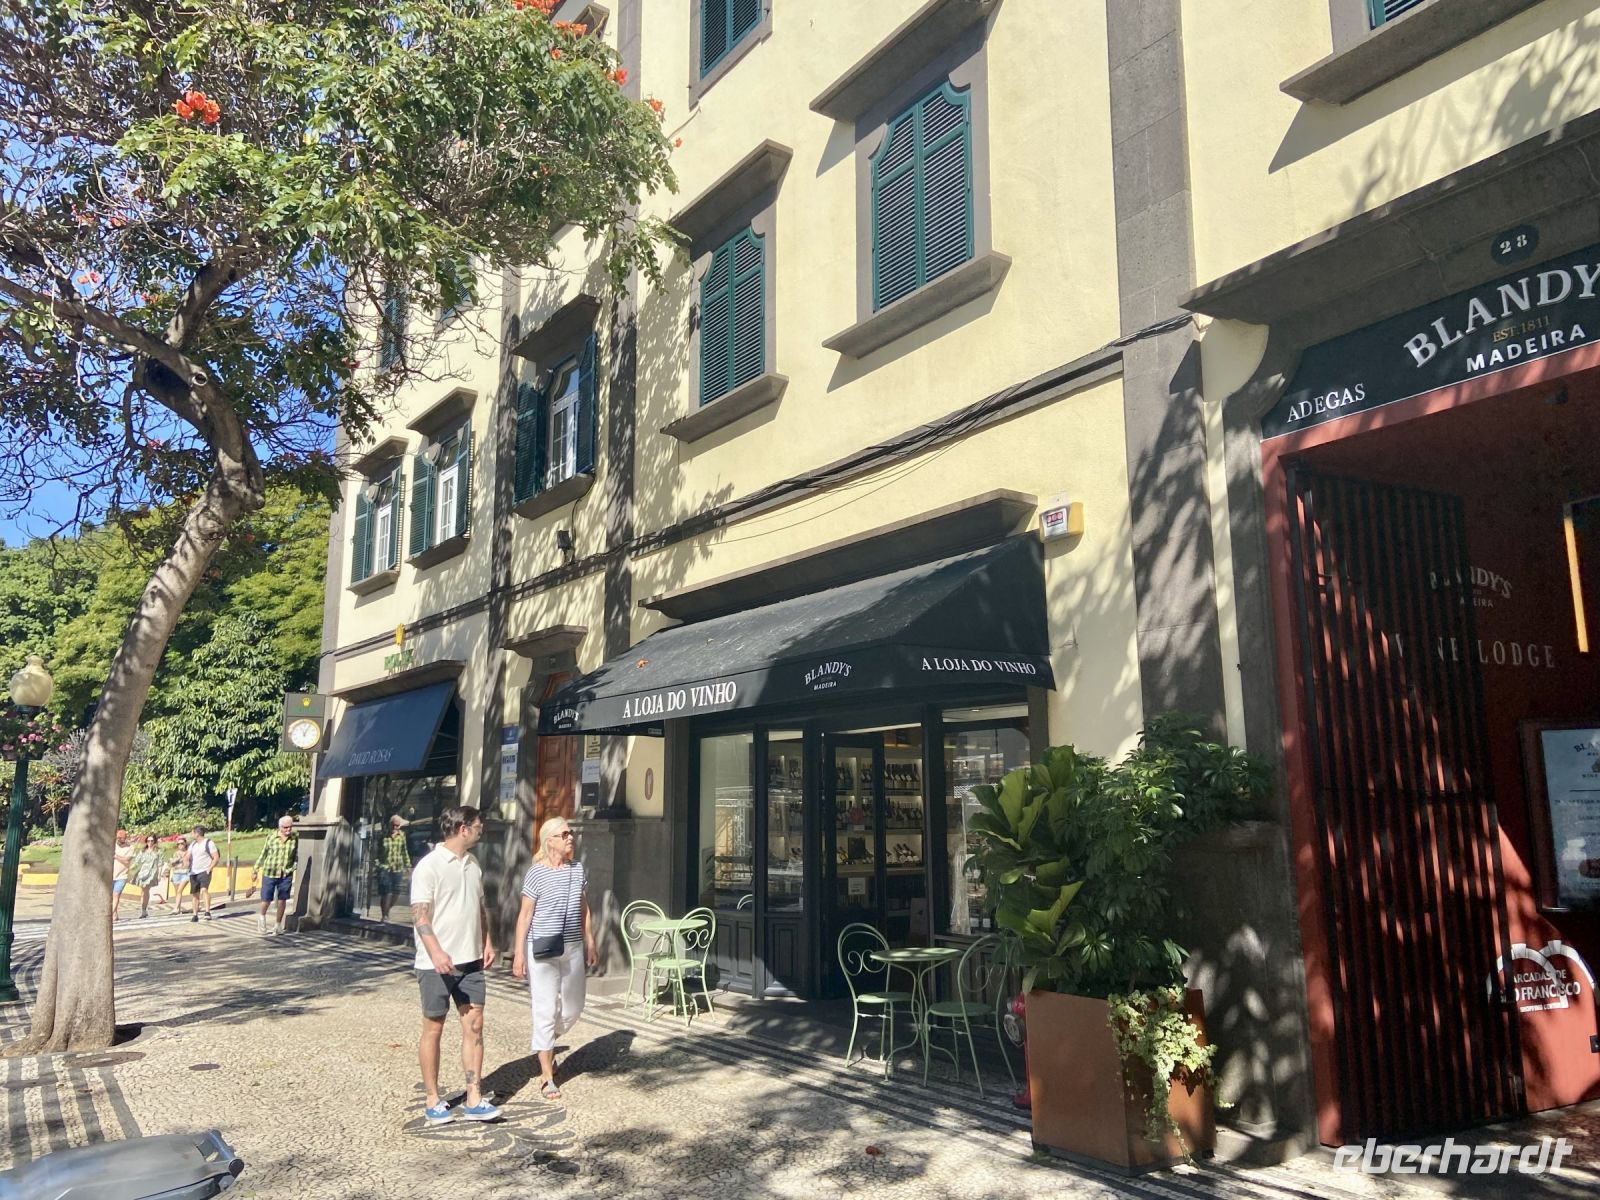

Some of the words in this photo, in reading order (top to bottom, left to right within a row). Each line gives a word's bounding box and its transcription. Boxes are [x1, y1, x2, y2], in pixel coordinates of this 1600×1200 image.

[1499, 233, 1529, 255] 28
[1520, 314, 1551, 334] 1811
[1466, 323, 1587, 373] MADEIRA
[1286, 383, 1366, 423] ADEGAS
[921, 657, 933, 671] A
[933, 657, 970, 672] LOJA
[970, 659, 993, 672] DO
[994, 660, 1036, 675] VINHO
[1477, 639, 1556, 668] LODGE
[804, 661, 852, 686] BLANDY'S
[622, 701, 631, 719] A
[634, 693, 664, 718] LOJA
[667, 689, 686, 712] DO
[690, 681, 737, 708] VINHO
